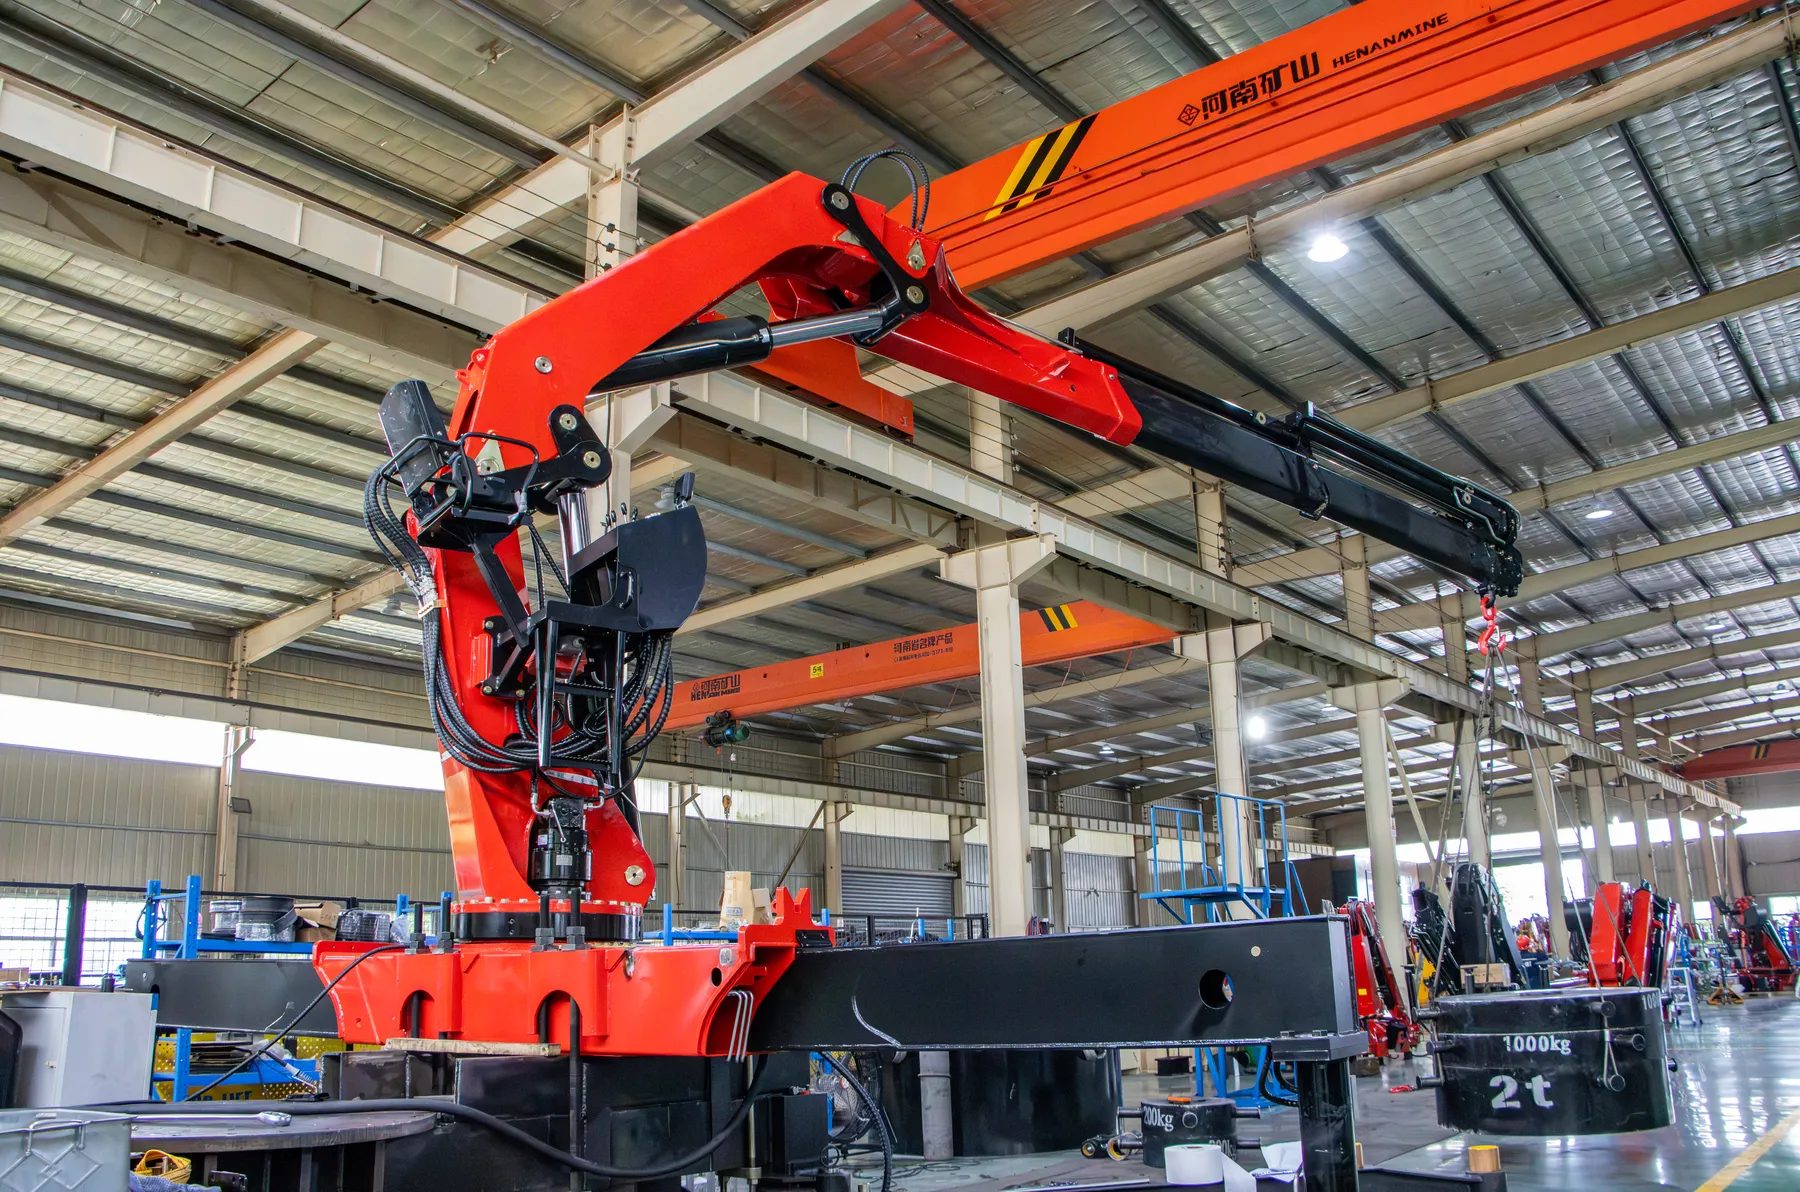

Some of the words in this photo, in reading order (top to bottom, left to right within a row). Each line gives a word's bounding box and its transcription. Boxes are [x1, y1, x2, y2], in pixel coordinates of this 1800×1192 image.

[1332, 13, 1449, 69] HENANMINE
[1201, 51, 1320, 120] 河南矿山
[1503, 1035, 1572, 1056] 1000kg
[1143, 1106, 1174, 1132] 200kg
